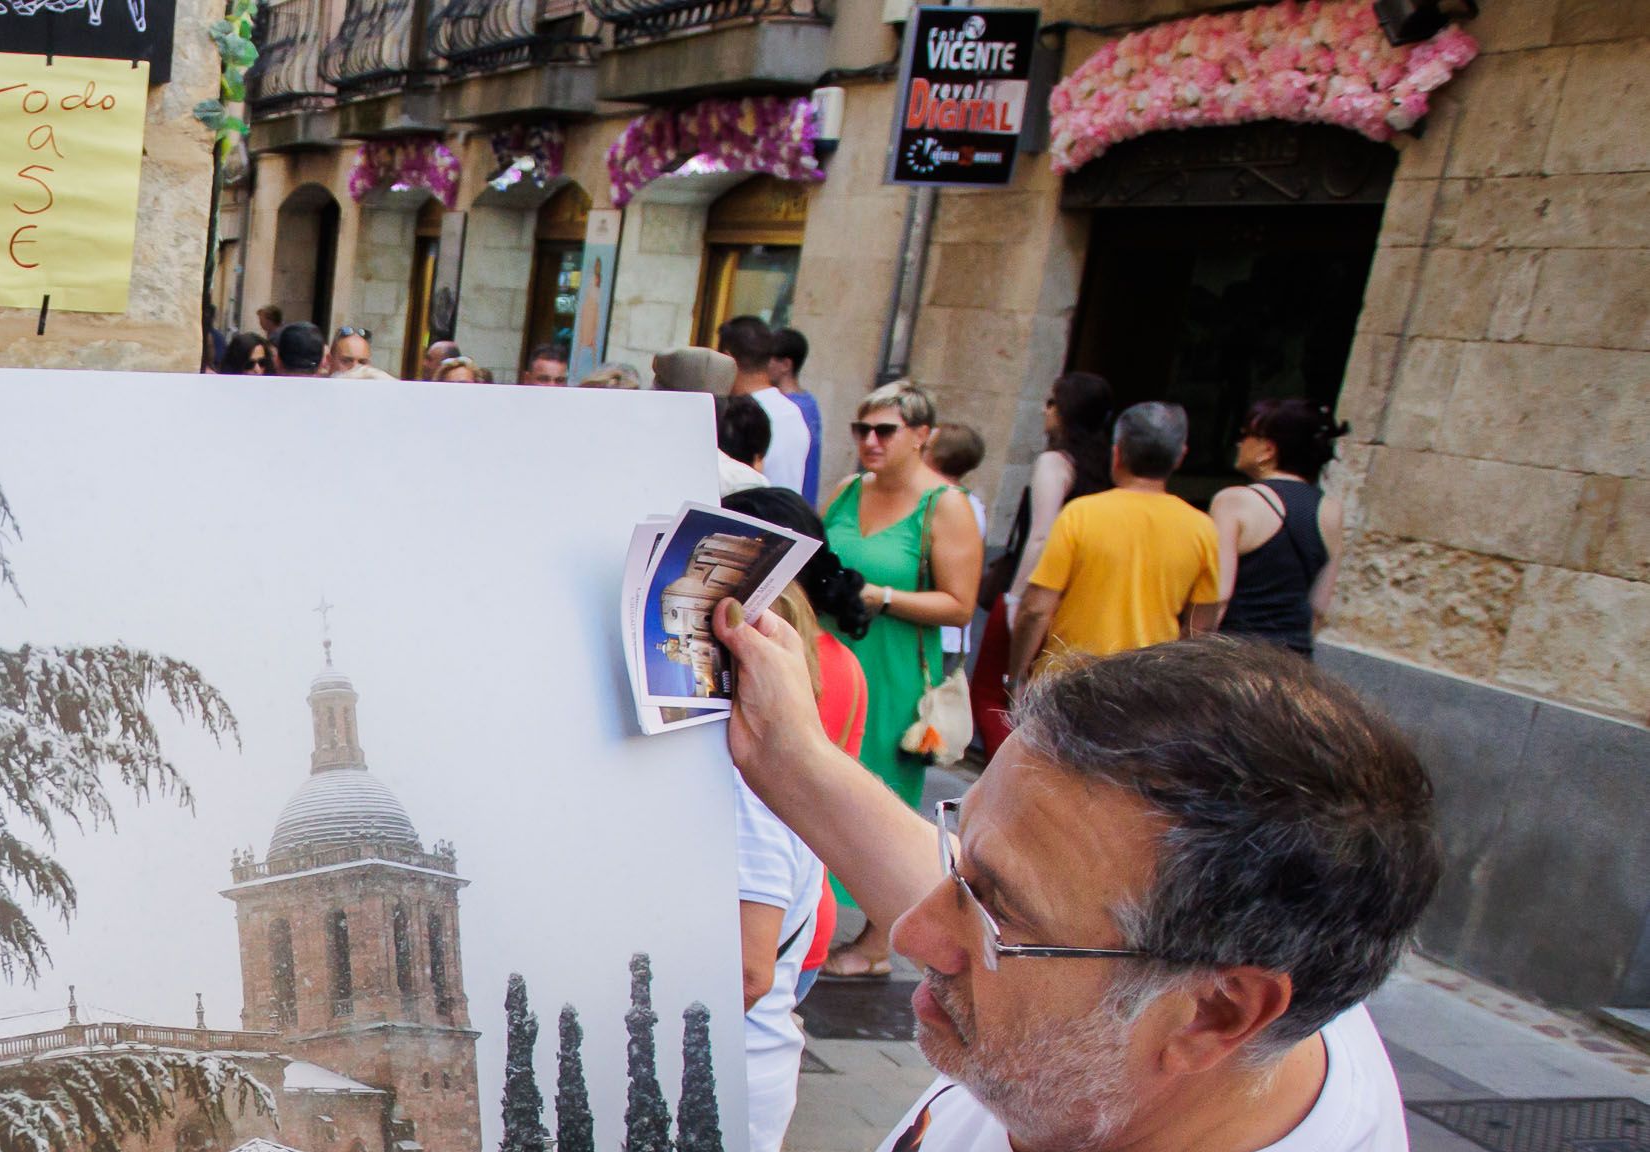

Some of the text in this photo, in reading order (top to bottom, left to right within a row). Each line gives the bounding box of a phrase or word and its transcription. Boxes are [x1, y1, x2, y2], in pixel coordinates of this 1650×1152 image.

[927, 41, 1017, 72] VICENTE
[906, 77, 1014, 132] DIGITAL
[27, 124, 64, 159] a
